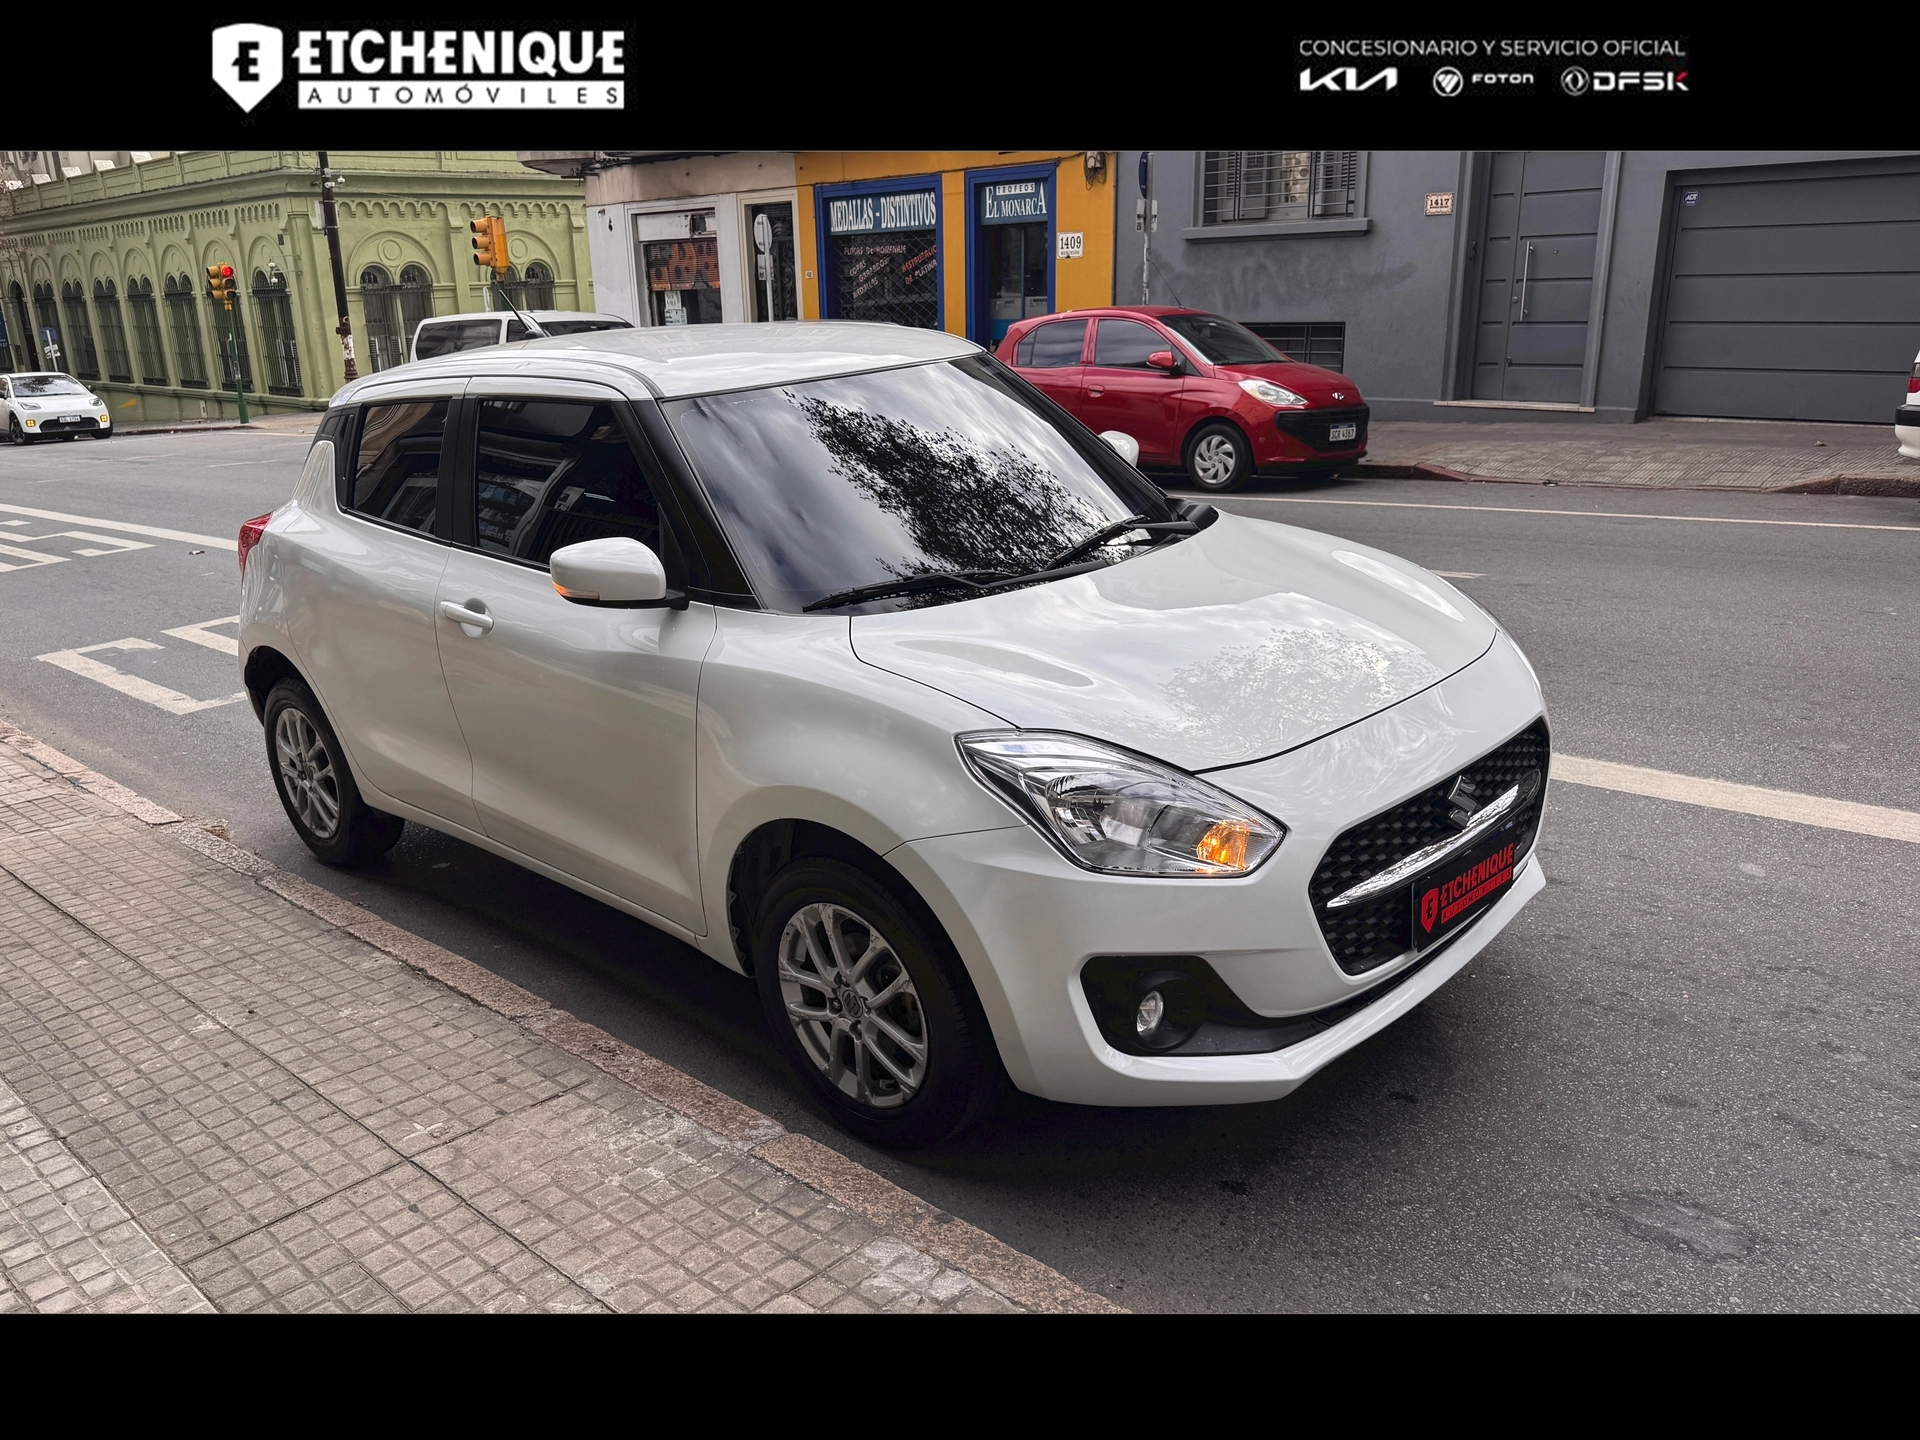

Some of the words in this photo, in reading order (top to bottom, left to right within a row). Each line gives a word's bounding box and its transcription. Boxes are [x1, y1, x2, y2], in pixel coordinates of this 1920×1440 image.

[997, 183, 1034, 194] TROFEOS
[1001, 181, 1047, 217] MONARCA
[1430, 198, 1450, 206] 1417
[1685, 193, 1698, 201] ADT
[830, 198, 874, 232] MEDALLAS
[880, 191, 936, 229] DISTINTIVOS
[1060, 235, 1082, 250] 1409
[1439, 843, 1514, 908] ETCHENIQUE
